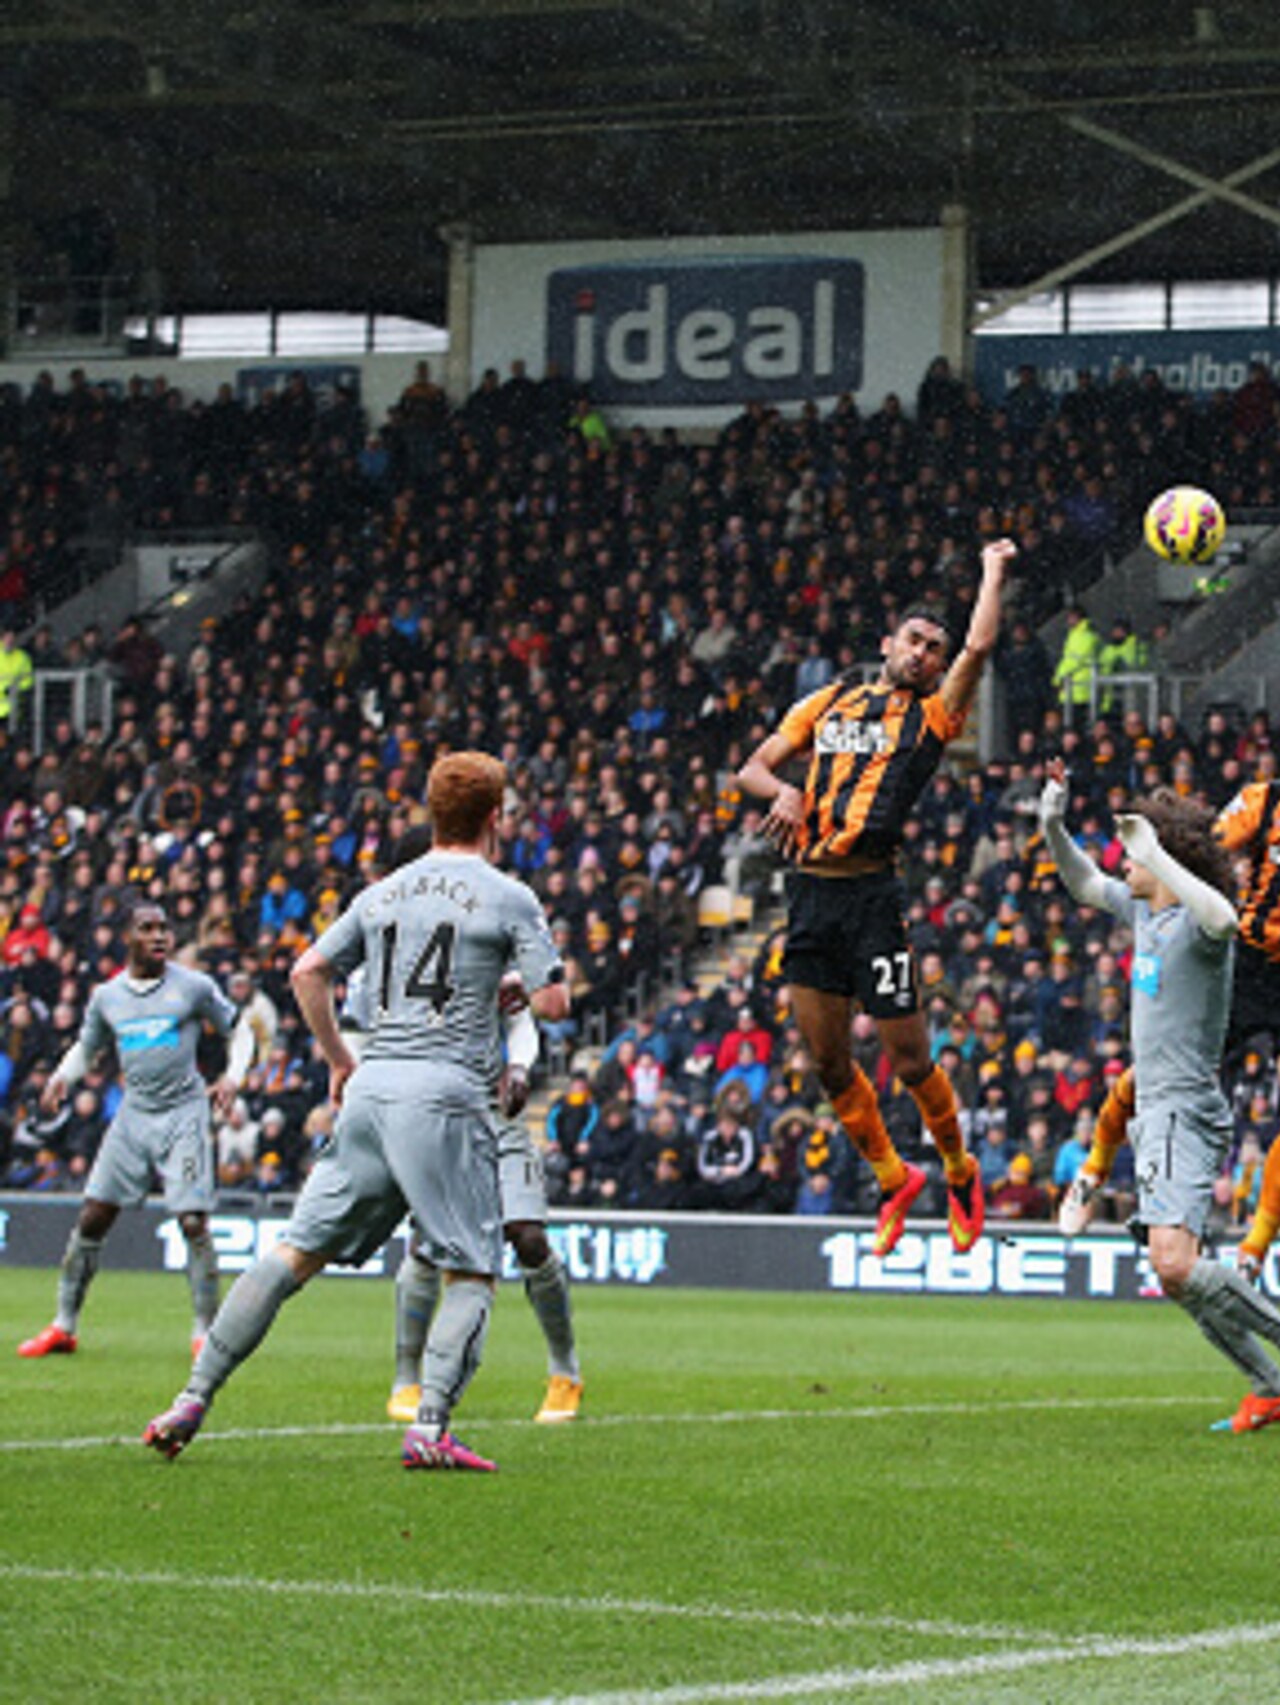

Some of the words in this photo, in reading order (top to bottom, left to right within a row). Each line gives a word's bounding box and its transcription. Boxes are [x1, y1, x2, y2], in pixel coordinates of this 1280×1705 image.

[573, 279, 836, 382] ideal
[381, 920, 455, 1015] 14
[871, 951, 910, 995] 27
[821, 1232, 1138, 1296] 12BET
